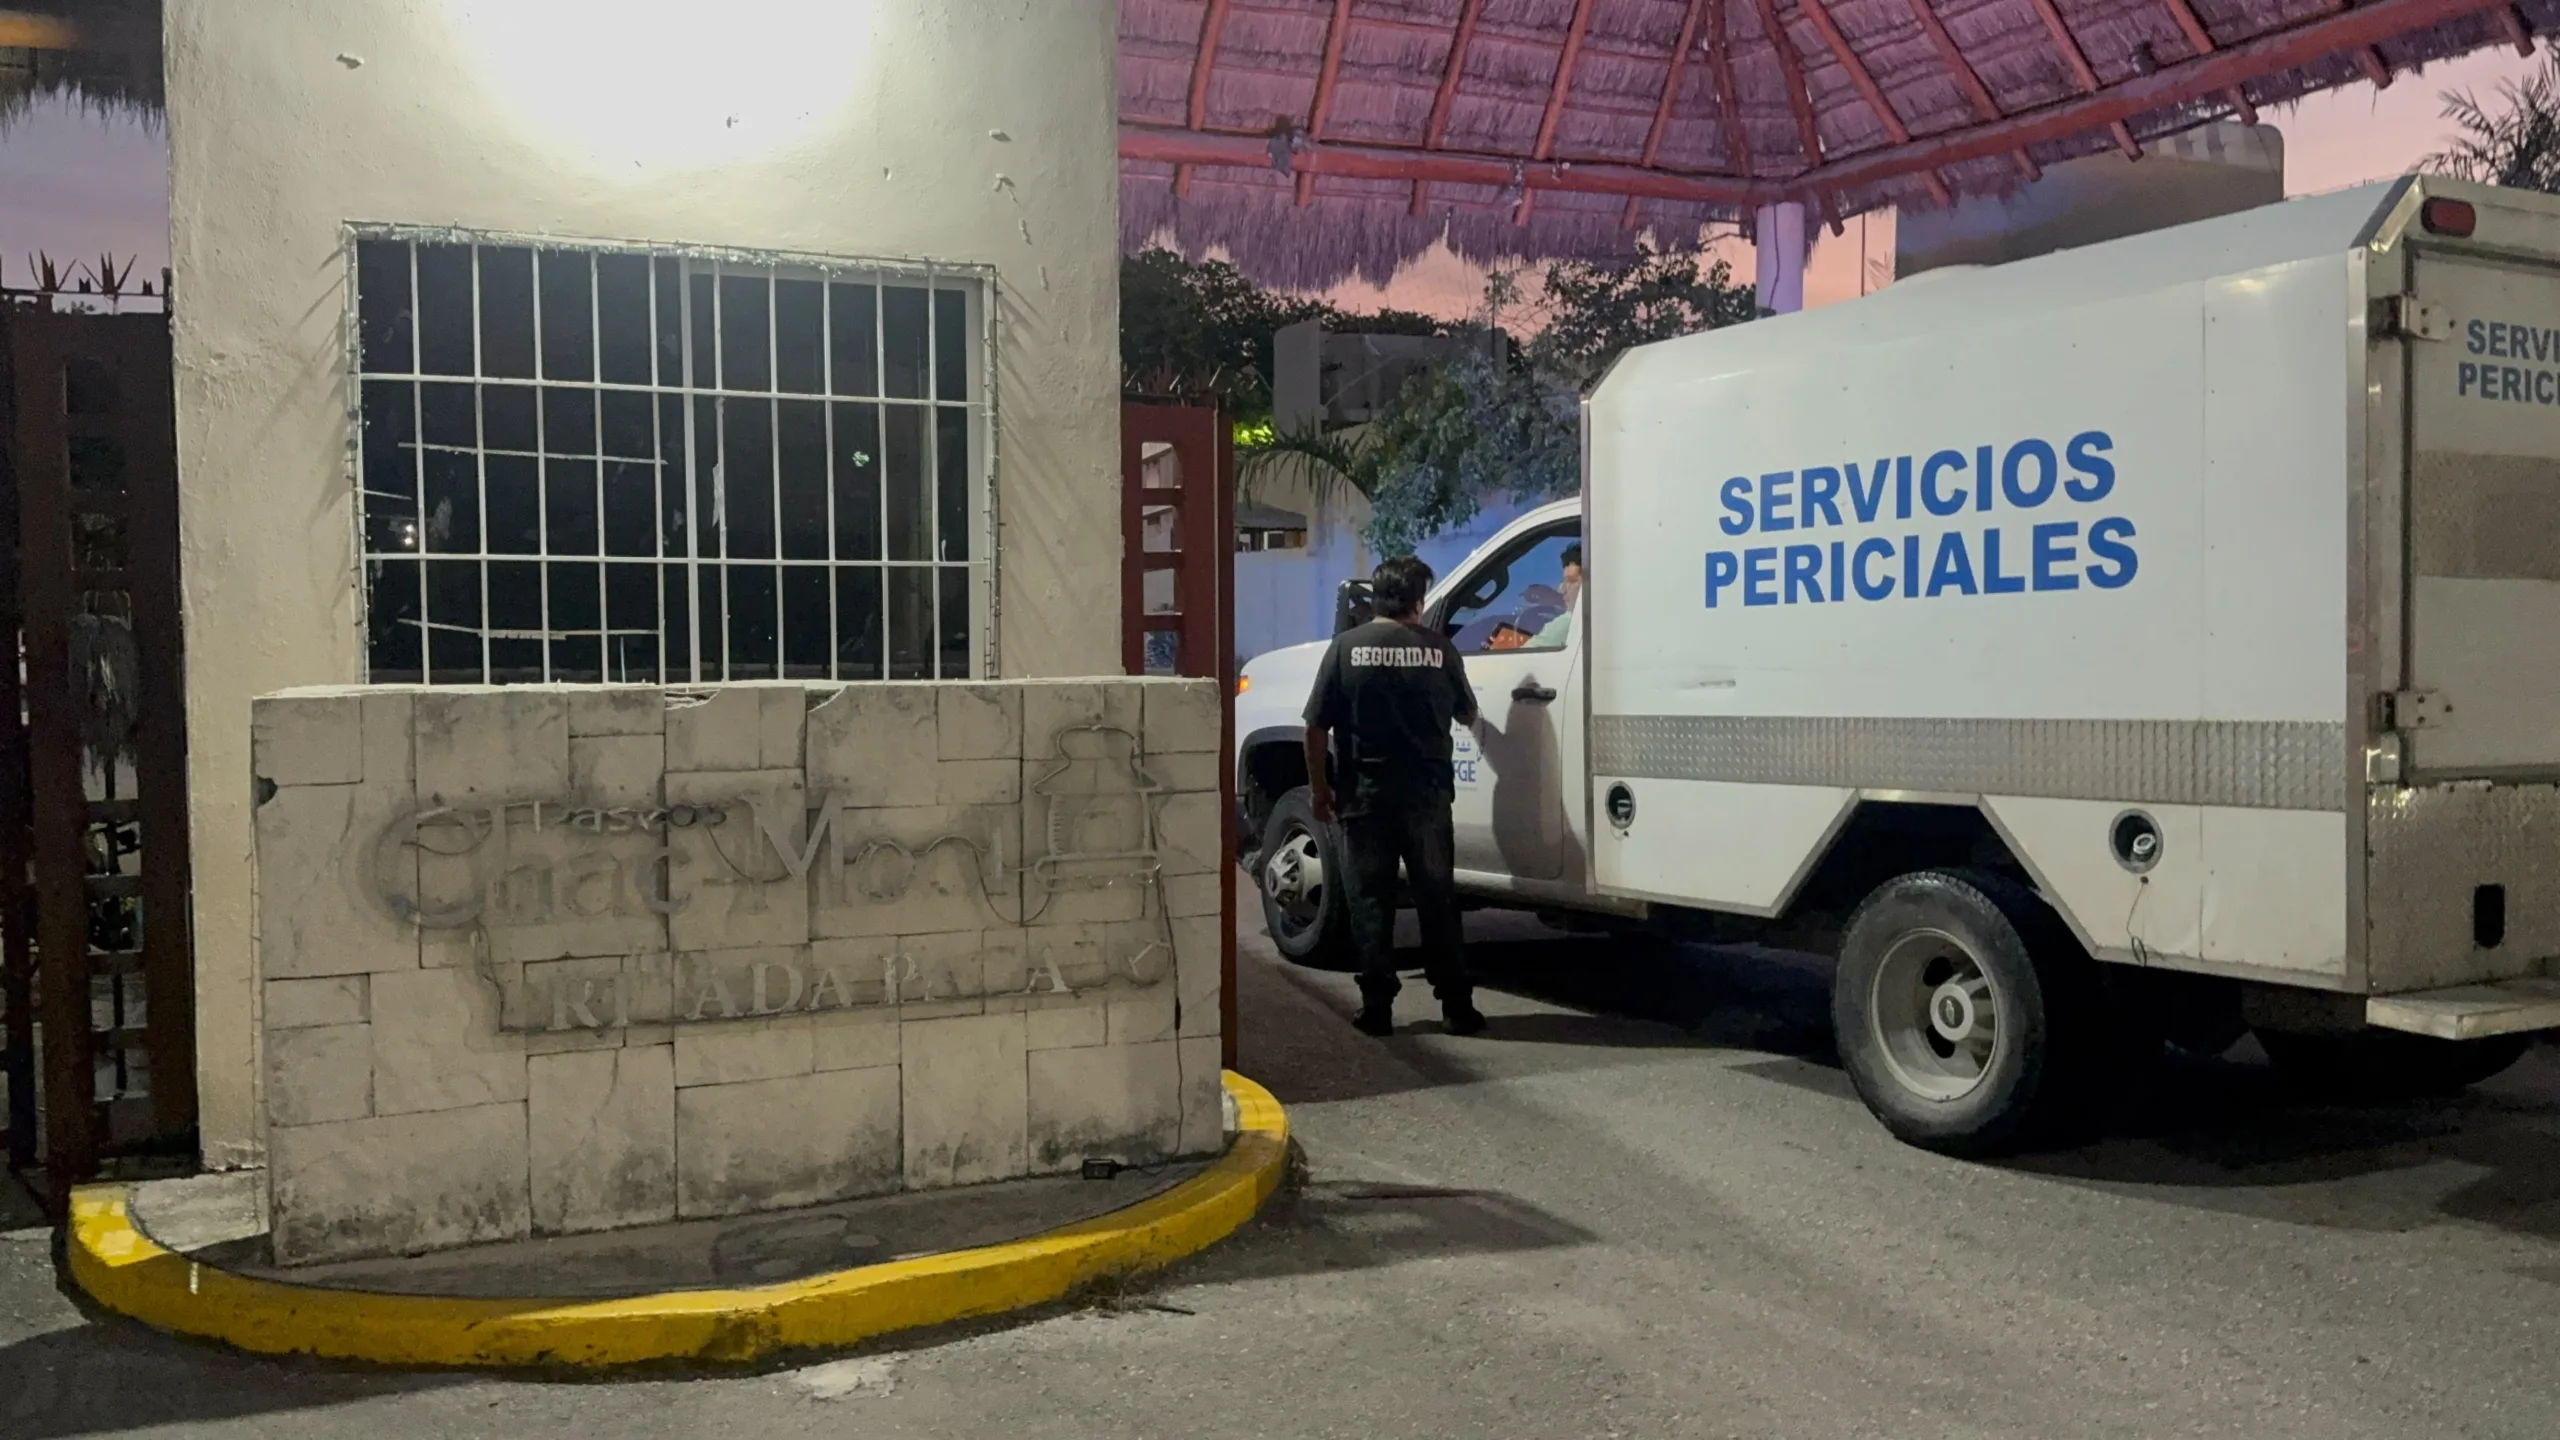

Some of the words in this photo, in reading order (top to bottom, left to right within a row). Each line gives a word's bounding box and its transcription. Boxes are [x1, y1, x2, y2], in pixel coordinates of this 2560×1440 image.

[1718, 430, 2116, 537] SERVICIOS
[1704, 516, 2139, 609] PERICIALES
[1351, 646, 1443, 669] SEGURIDAD
